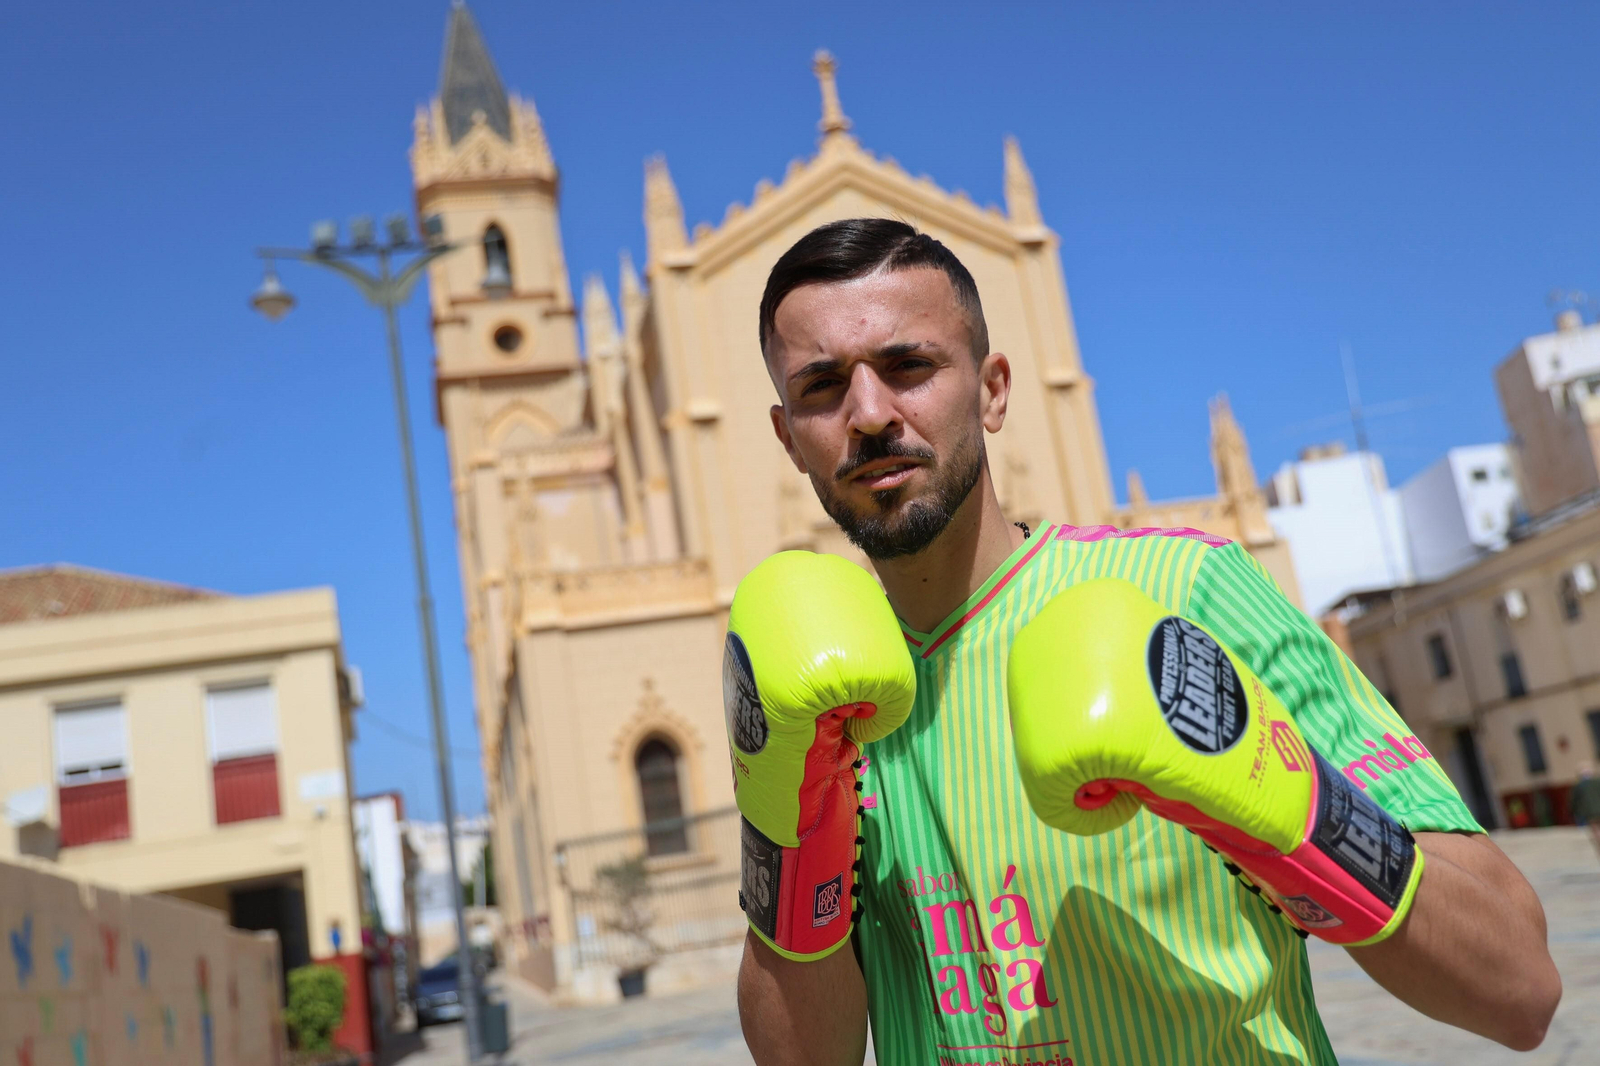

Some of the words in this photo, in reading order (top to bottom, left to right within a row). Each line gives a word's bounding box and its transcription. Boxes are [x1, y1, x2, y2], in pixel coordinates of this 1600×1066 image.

[1160, 623, 1179, 706] PROFESSIONAL
[1171, 618, 1218, 751] LEADERS
[1222, 658, 1235, 693] GEAR
[1222, 691, 1236, 740] FIGHT
[1251, 676, 1266, 727] BALDO
[1249, 730, 1266, 781] TEAM
